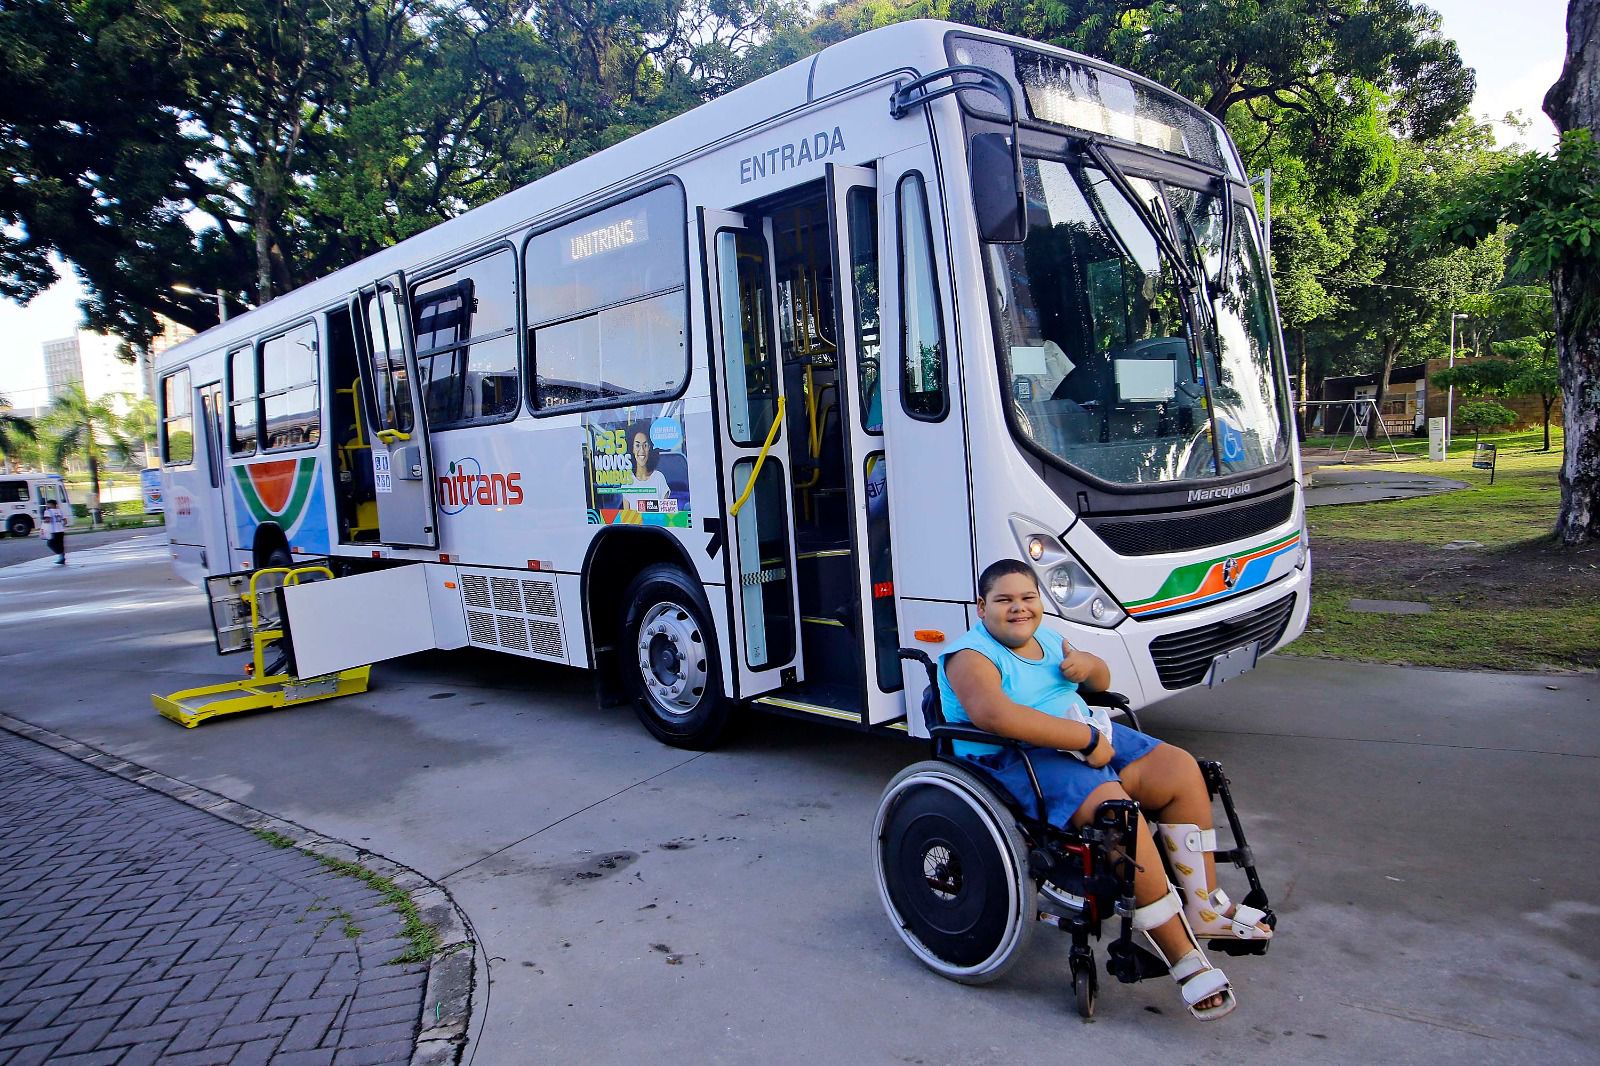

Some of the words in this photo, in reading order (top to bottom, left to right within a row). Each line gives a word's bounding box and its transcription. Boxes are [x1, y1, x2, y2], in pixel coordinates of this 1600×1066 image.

[740, 126, 846, 184] ENTRADA
[570, 219, 635, 260] UNITRANS
[594, 453, 633, 471] NOVOS
[438, 462, 524, 506] nitrans
[1187, 482, 1251, 503] Marcopolo
